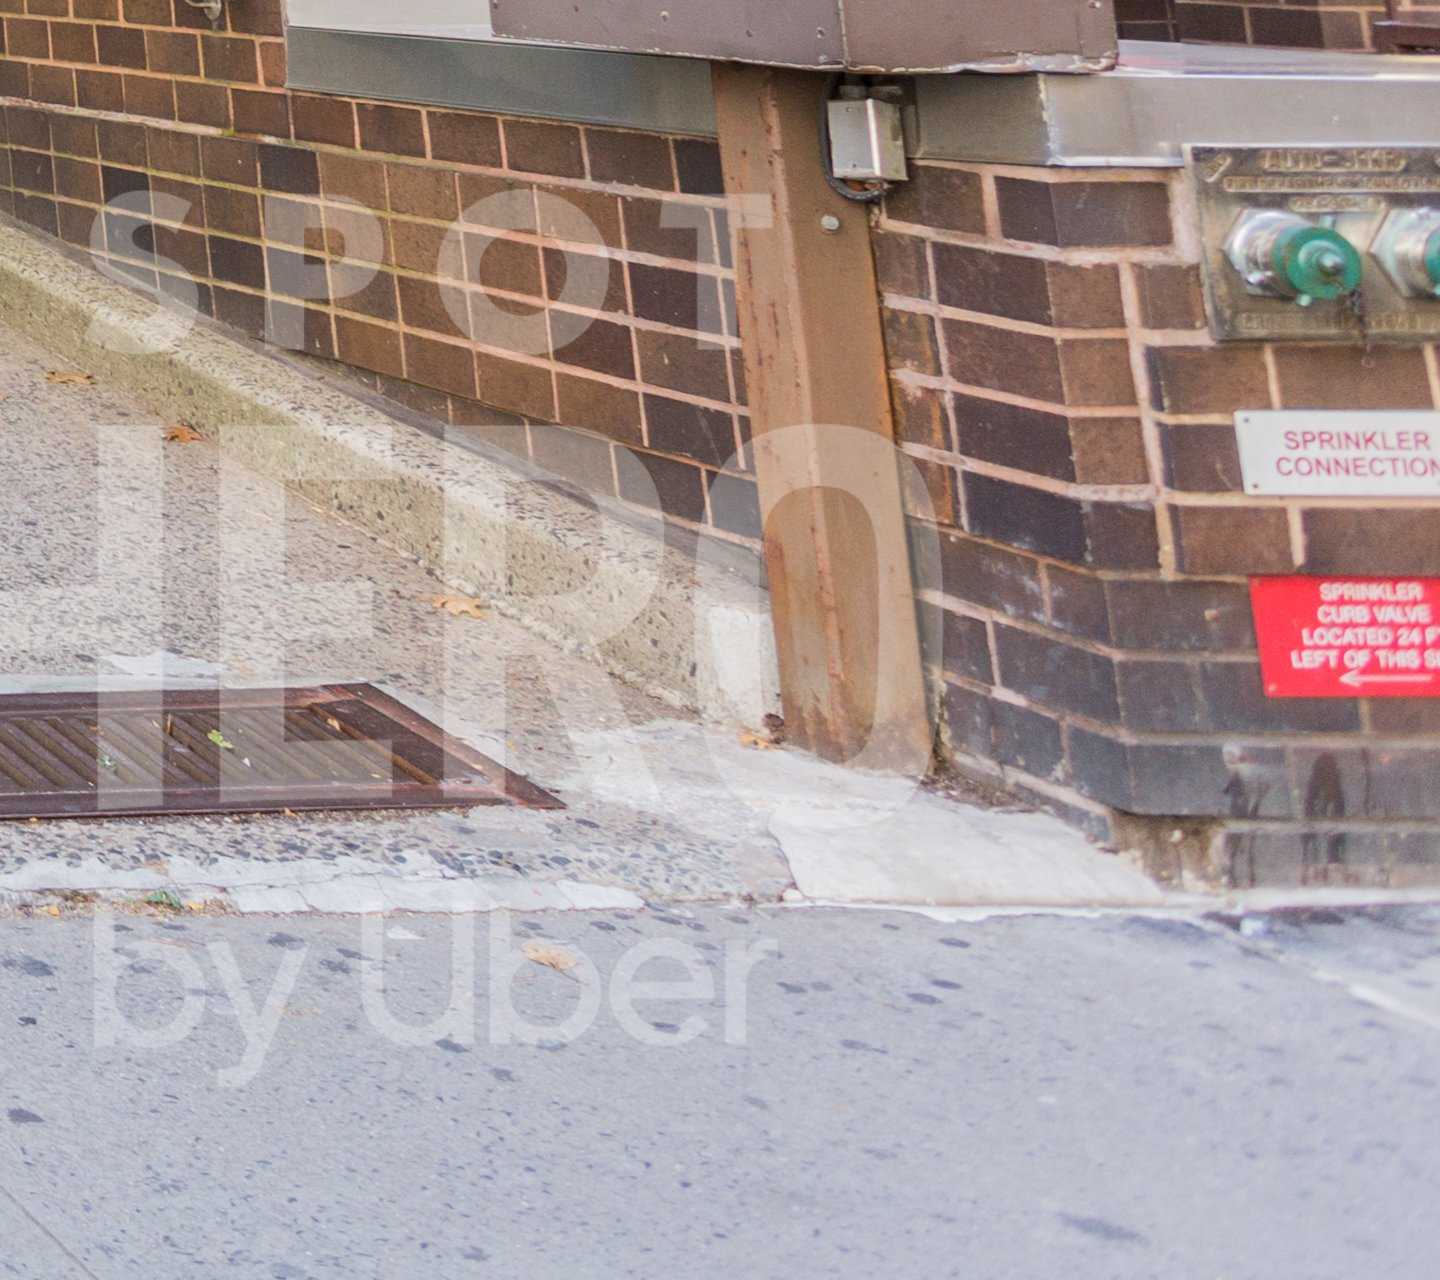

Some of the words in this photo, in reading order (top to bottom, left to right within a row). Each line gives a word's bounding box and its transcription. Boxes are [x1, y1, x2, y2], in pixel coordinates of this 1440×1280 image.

[1284, 430, 1431, 451] SPRINKLER
[1320, 582, 1423, 600] SPRINKLER
[1317, 604, 1369, 623] CURB
[1372, 603, 1431, 623] VALVE
[1302, 627, 1392, 646] LOCATED
[1397, 627, 1422, 646] 24
[1291, 649, 1339, 669] LEFT
[1343, 649, 1369, 668] OF
[1374, 649, 1420, 669] THIS
